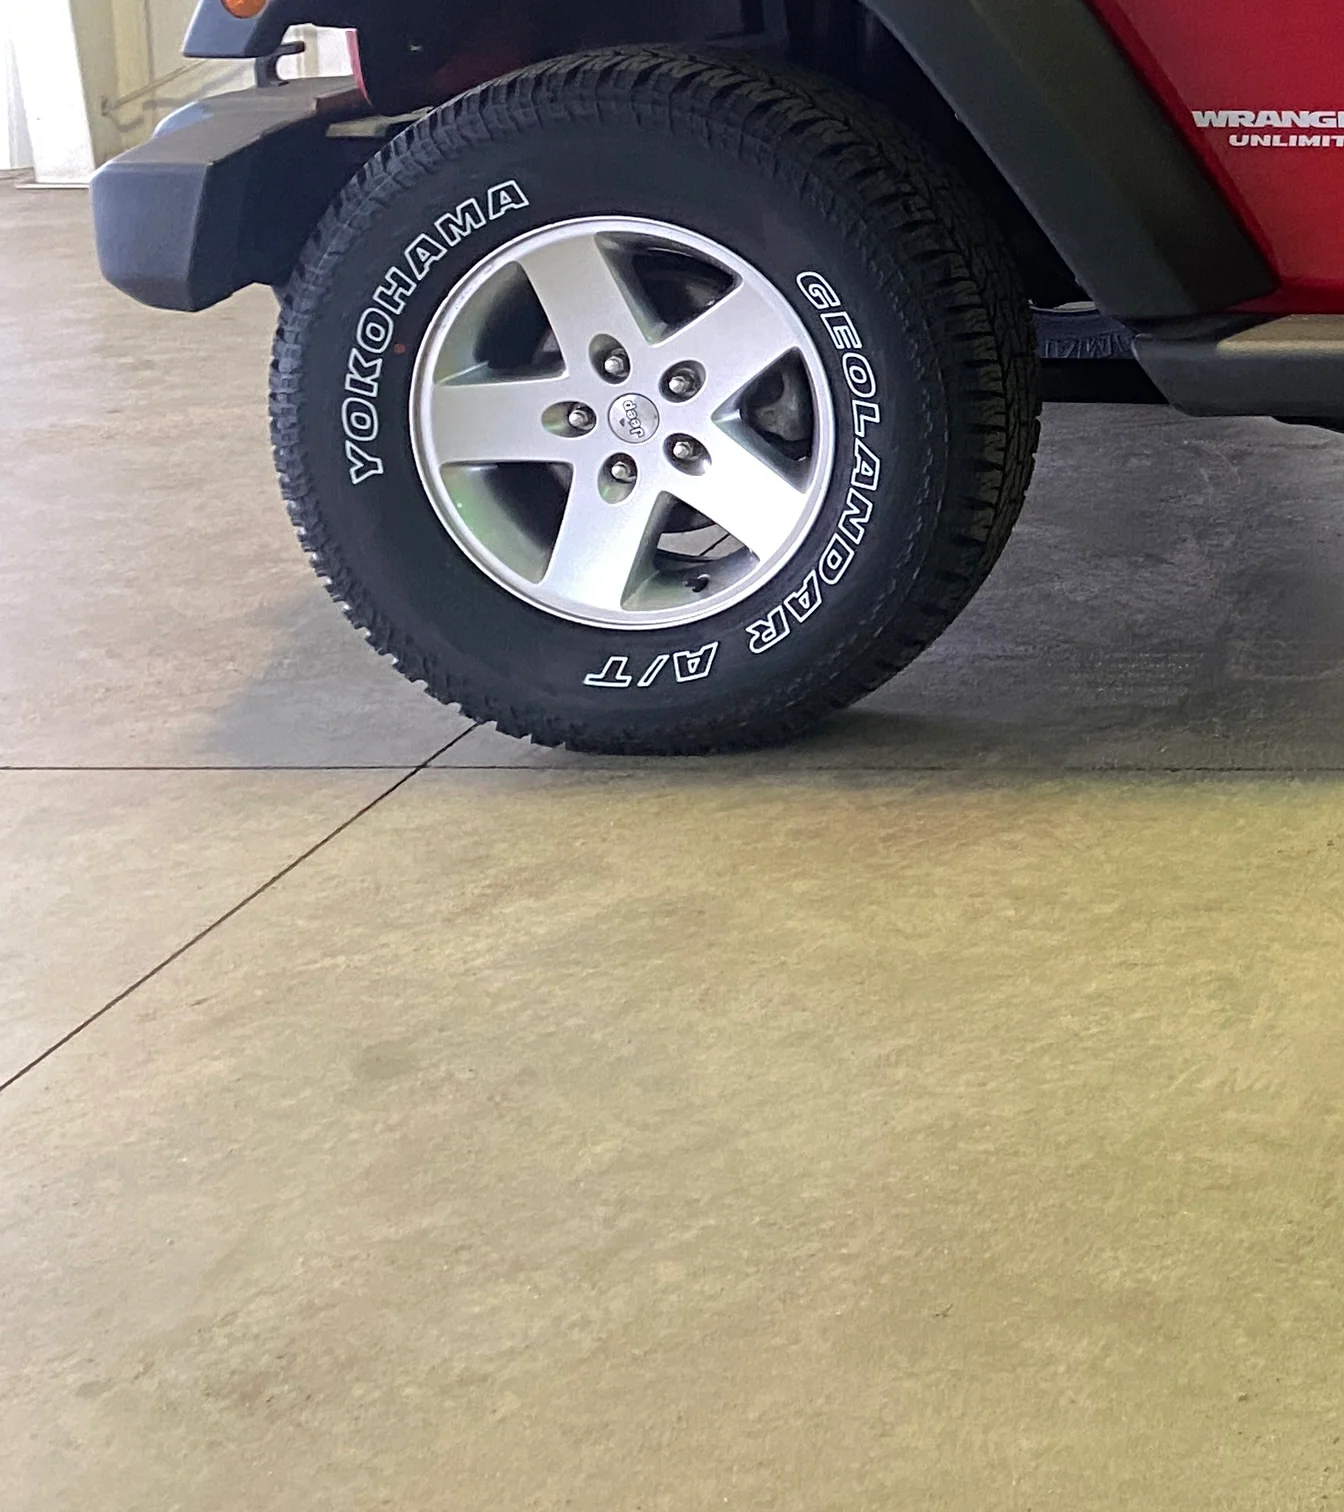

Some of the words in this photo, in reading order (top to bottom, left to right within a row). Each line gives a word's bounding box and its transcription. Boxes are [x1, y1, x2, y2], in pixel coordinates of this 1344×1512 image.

[342, 180, 529, 484] YOKOHAMA
[623, 399, 645, 438] Jeep
[746, 272, 880, 653] GEOLANDAR
[583, 642, 718, 687] A/T
